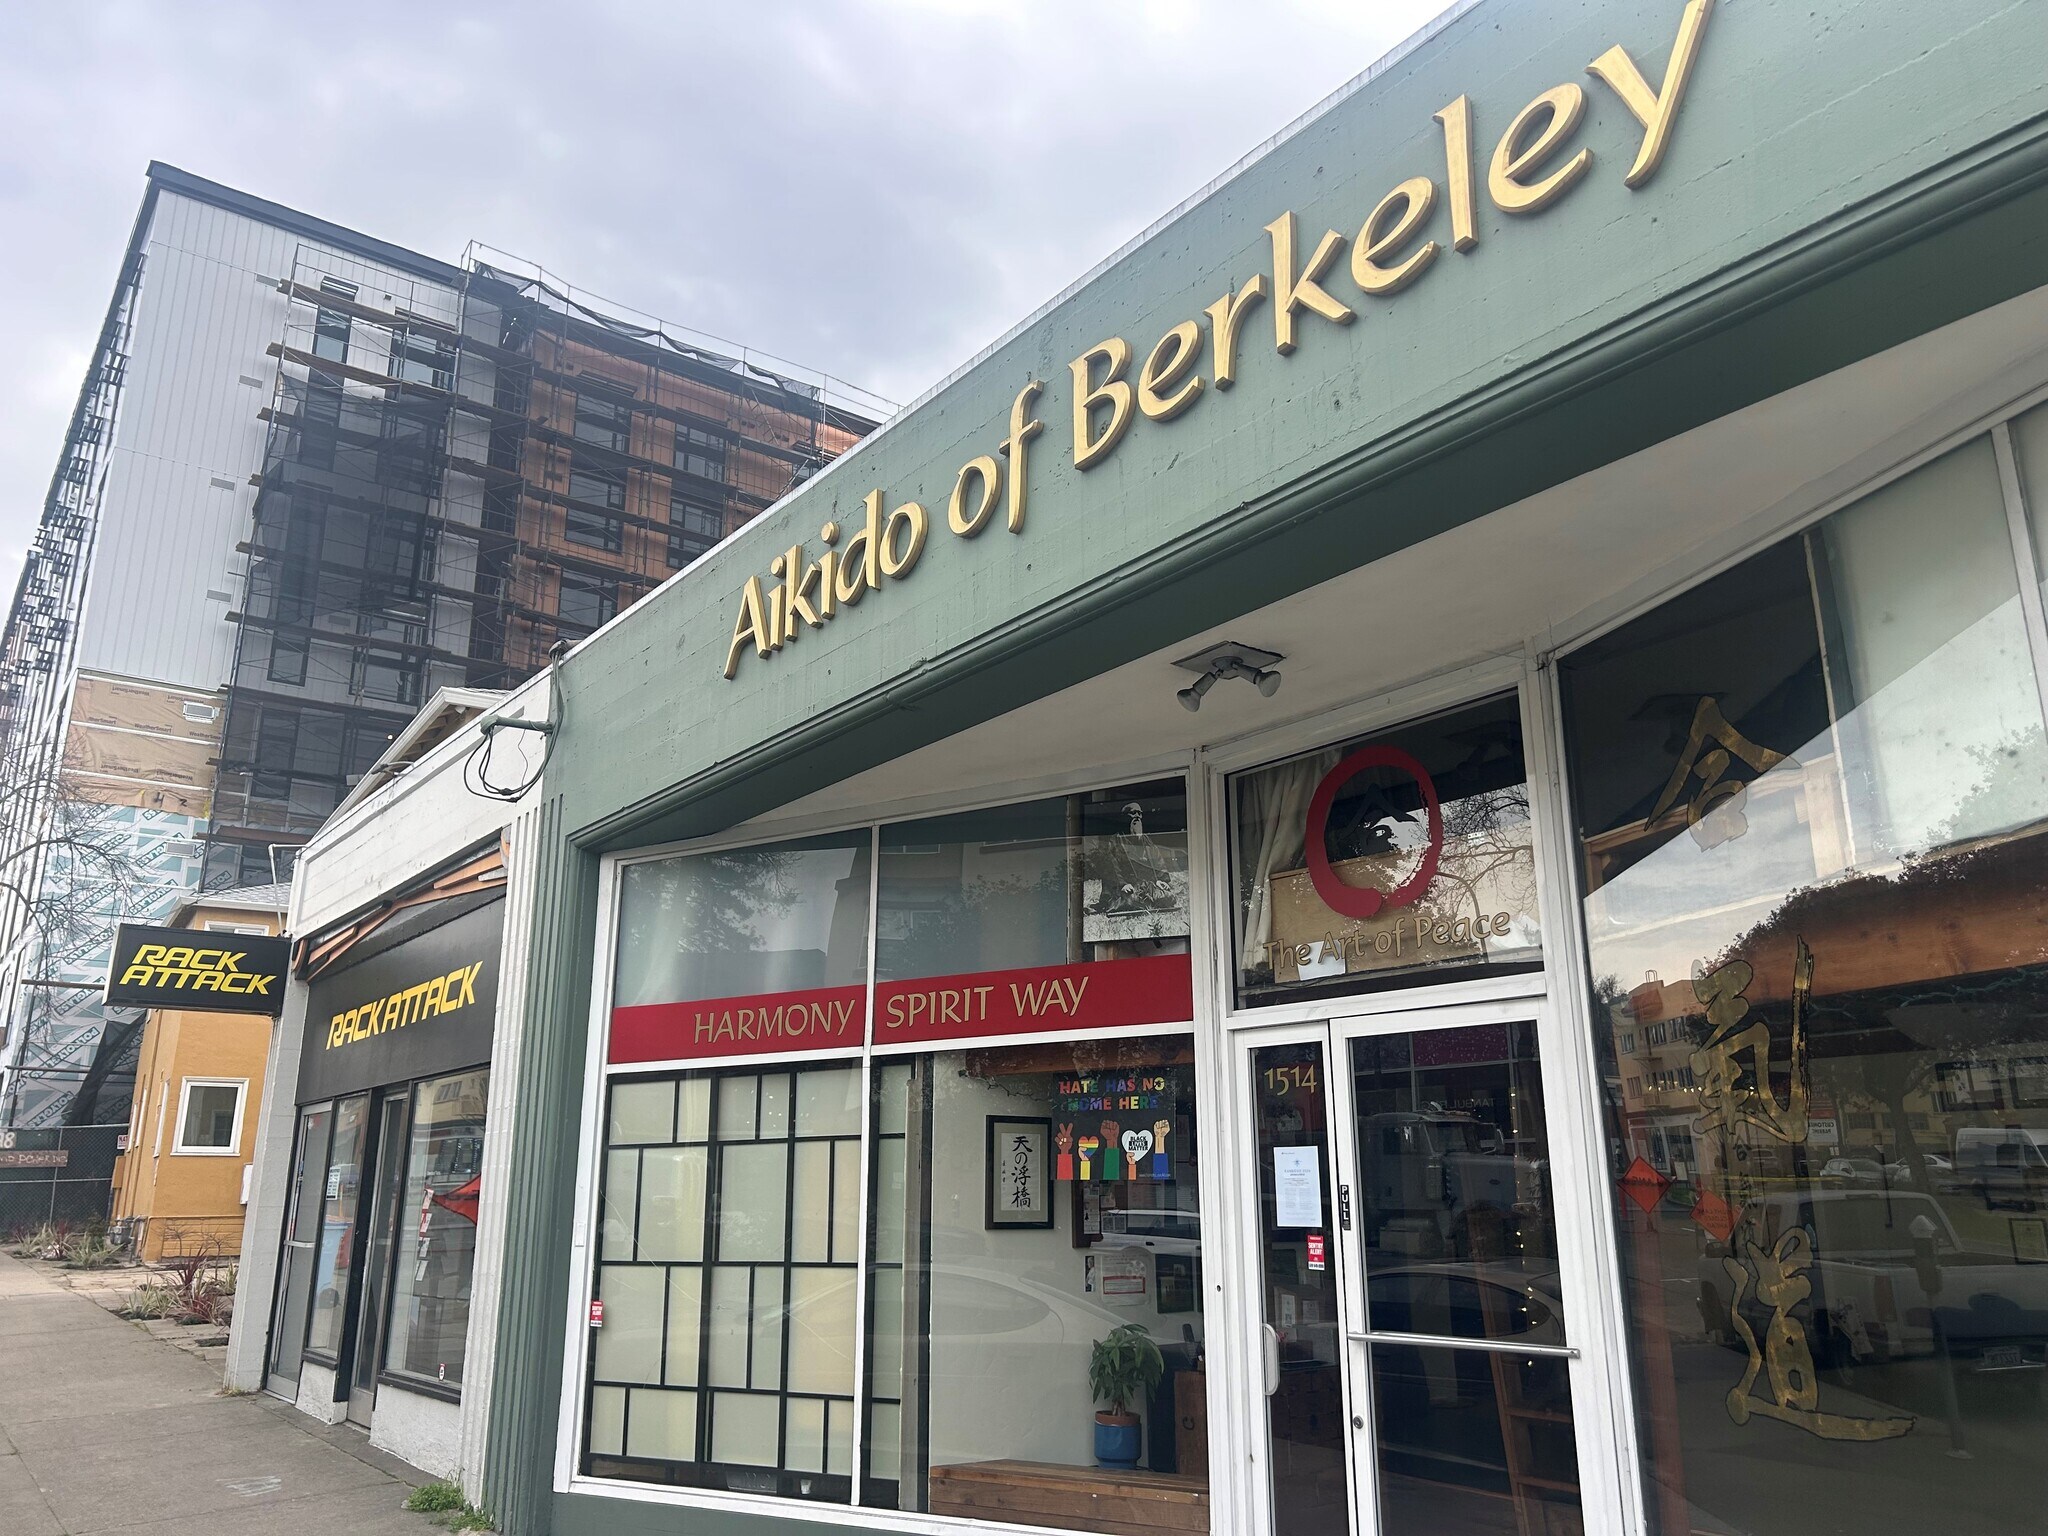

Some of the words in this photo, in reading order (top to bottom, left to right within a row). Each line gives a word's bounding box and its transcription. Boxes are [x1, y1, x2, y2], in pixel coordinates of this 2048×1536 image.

[723, 488, 929, 680] Aikido
[947, 380, 1044, 537] of
[1068, 0, 1713, 472] Berkeley
[132, 944, 247, 972] RACK
[1263, 940, 1311, 970] The
[1317, 930, 1365, 964] Art
[1374, 917, 1405, 957] of
[1413, 911, 1511, 949] Peace
[119, 965, 277, 995] ATTACK
[326, 997, 386, 1050] RACK
[381, 960, 484, 1034] ATTACK
[693, 999, 856, 1044] HARMONY
[886, 986, 994, 1028] SPIRIT
[1009, 976, 1089, 1017] WAY
[1059, 1079, 1098, 1094] HATE
[1105, 1078, 1136, 1093] HAS
[1142, 1077, 1165, 1091] NO
[1264, 1064, 1317, 1096] 1514
[1066, 1096, 1112, 1111] HOME
[1118, 1095, 1158, 1110] HERE
[1011, 1135, 1033, 1209] 天の浮橋
[1341, 1185, 1350, 1220] PULL
